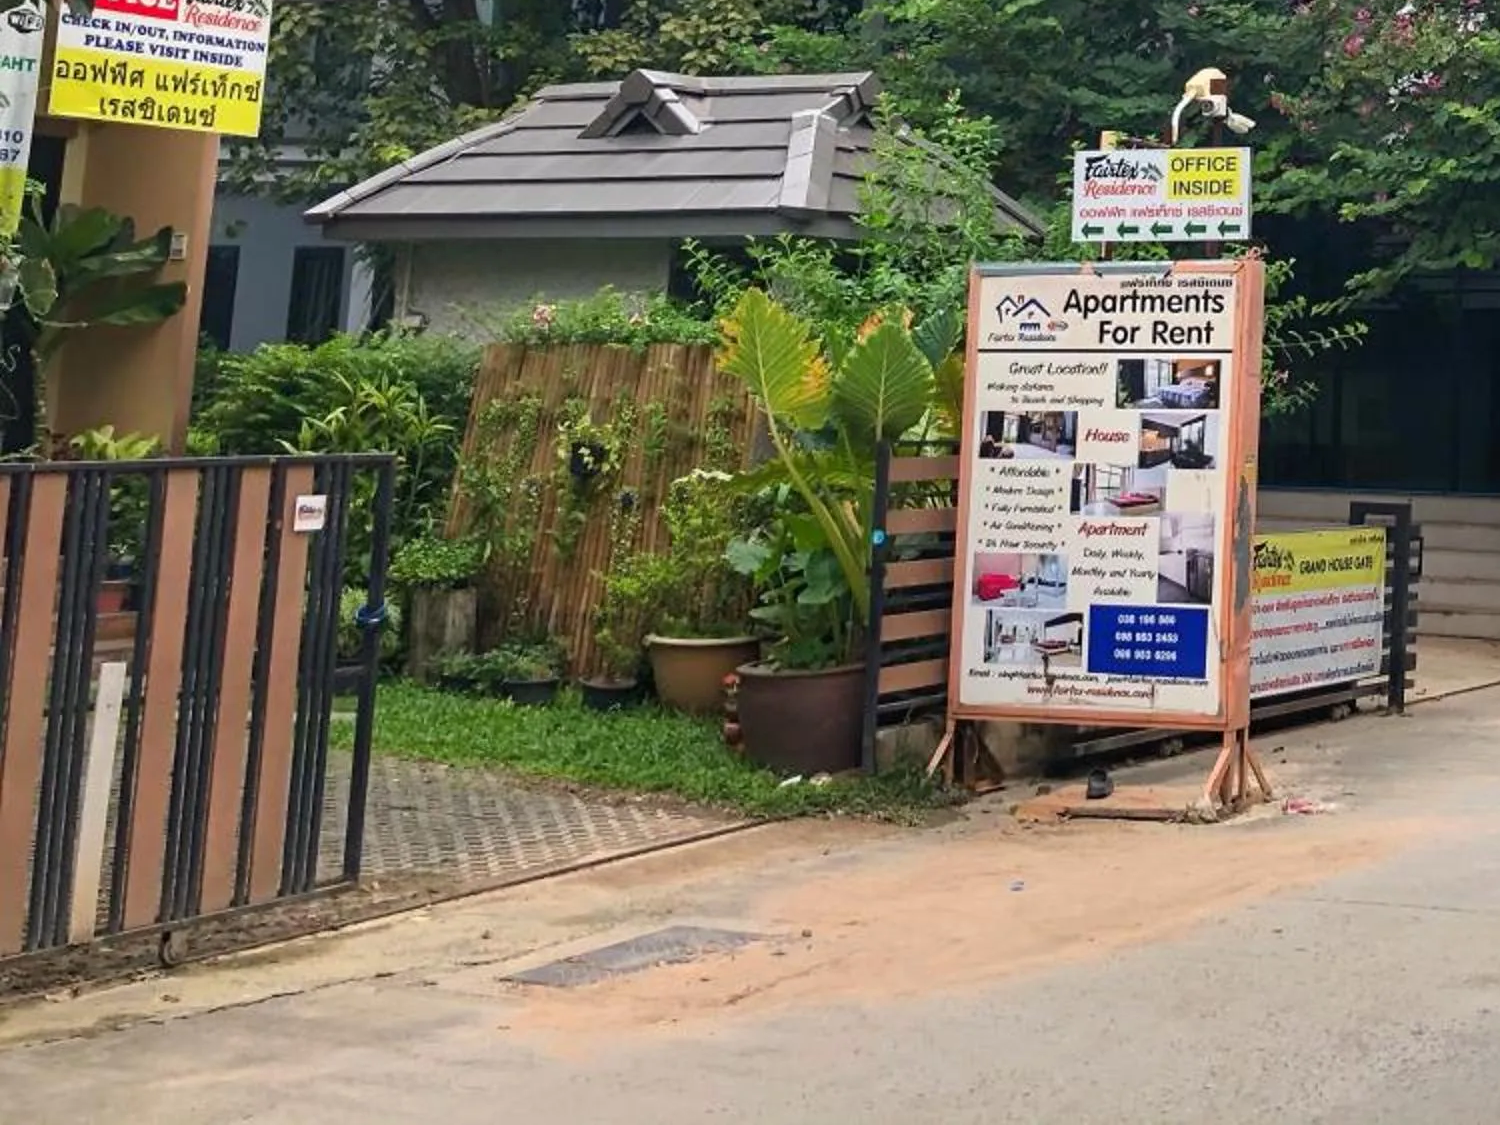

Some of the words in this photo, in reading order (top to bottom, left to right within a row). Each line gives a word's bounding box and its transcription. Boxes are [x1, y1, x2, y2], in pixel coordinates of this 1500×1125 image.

[61, 12, 112, 31] CHECK
[172, 30, 266, 53] INFORMATION
[84, 35, 144, 54] PLEASE
[149, 43, 190, 60] VISIT
[193, 48, 244, 68] INSIDE
[0, 57, 36, 72] AHT
[1171, 156, 1237, 172] OFFICE
[1173, 180, 1233, 195] INSIDE
[1063, 288, 1225, 319] Apartments
[1099, 320, 1140, 345] For
[1152, 321, 1214, 345] Rent
[1085, 428, 1130, 443] House
[1078, 522, 1147, 538] Apartment
[1300, 559, 1326, 574] GRAND
[1328, 556, 1354, 571] HOUSE
